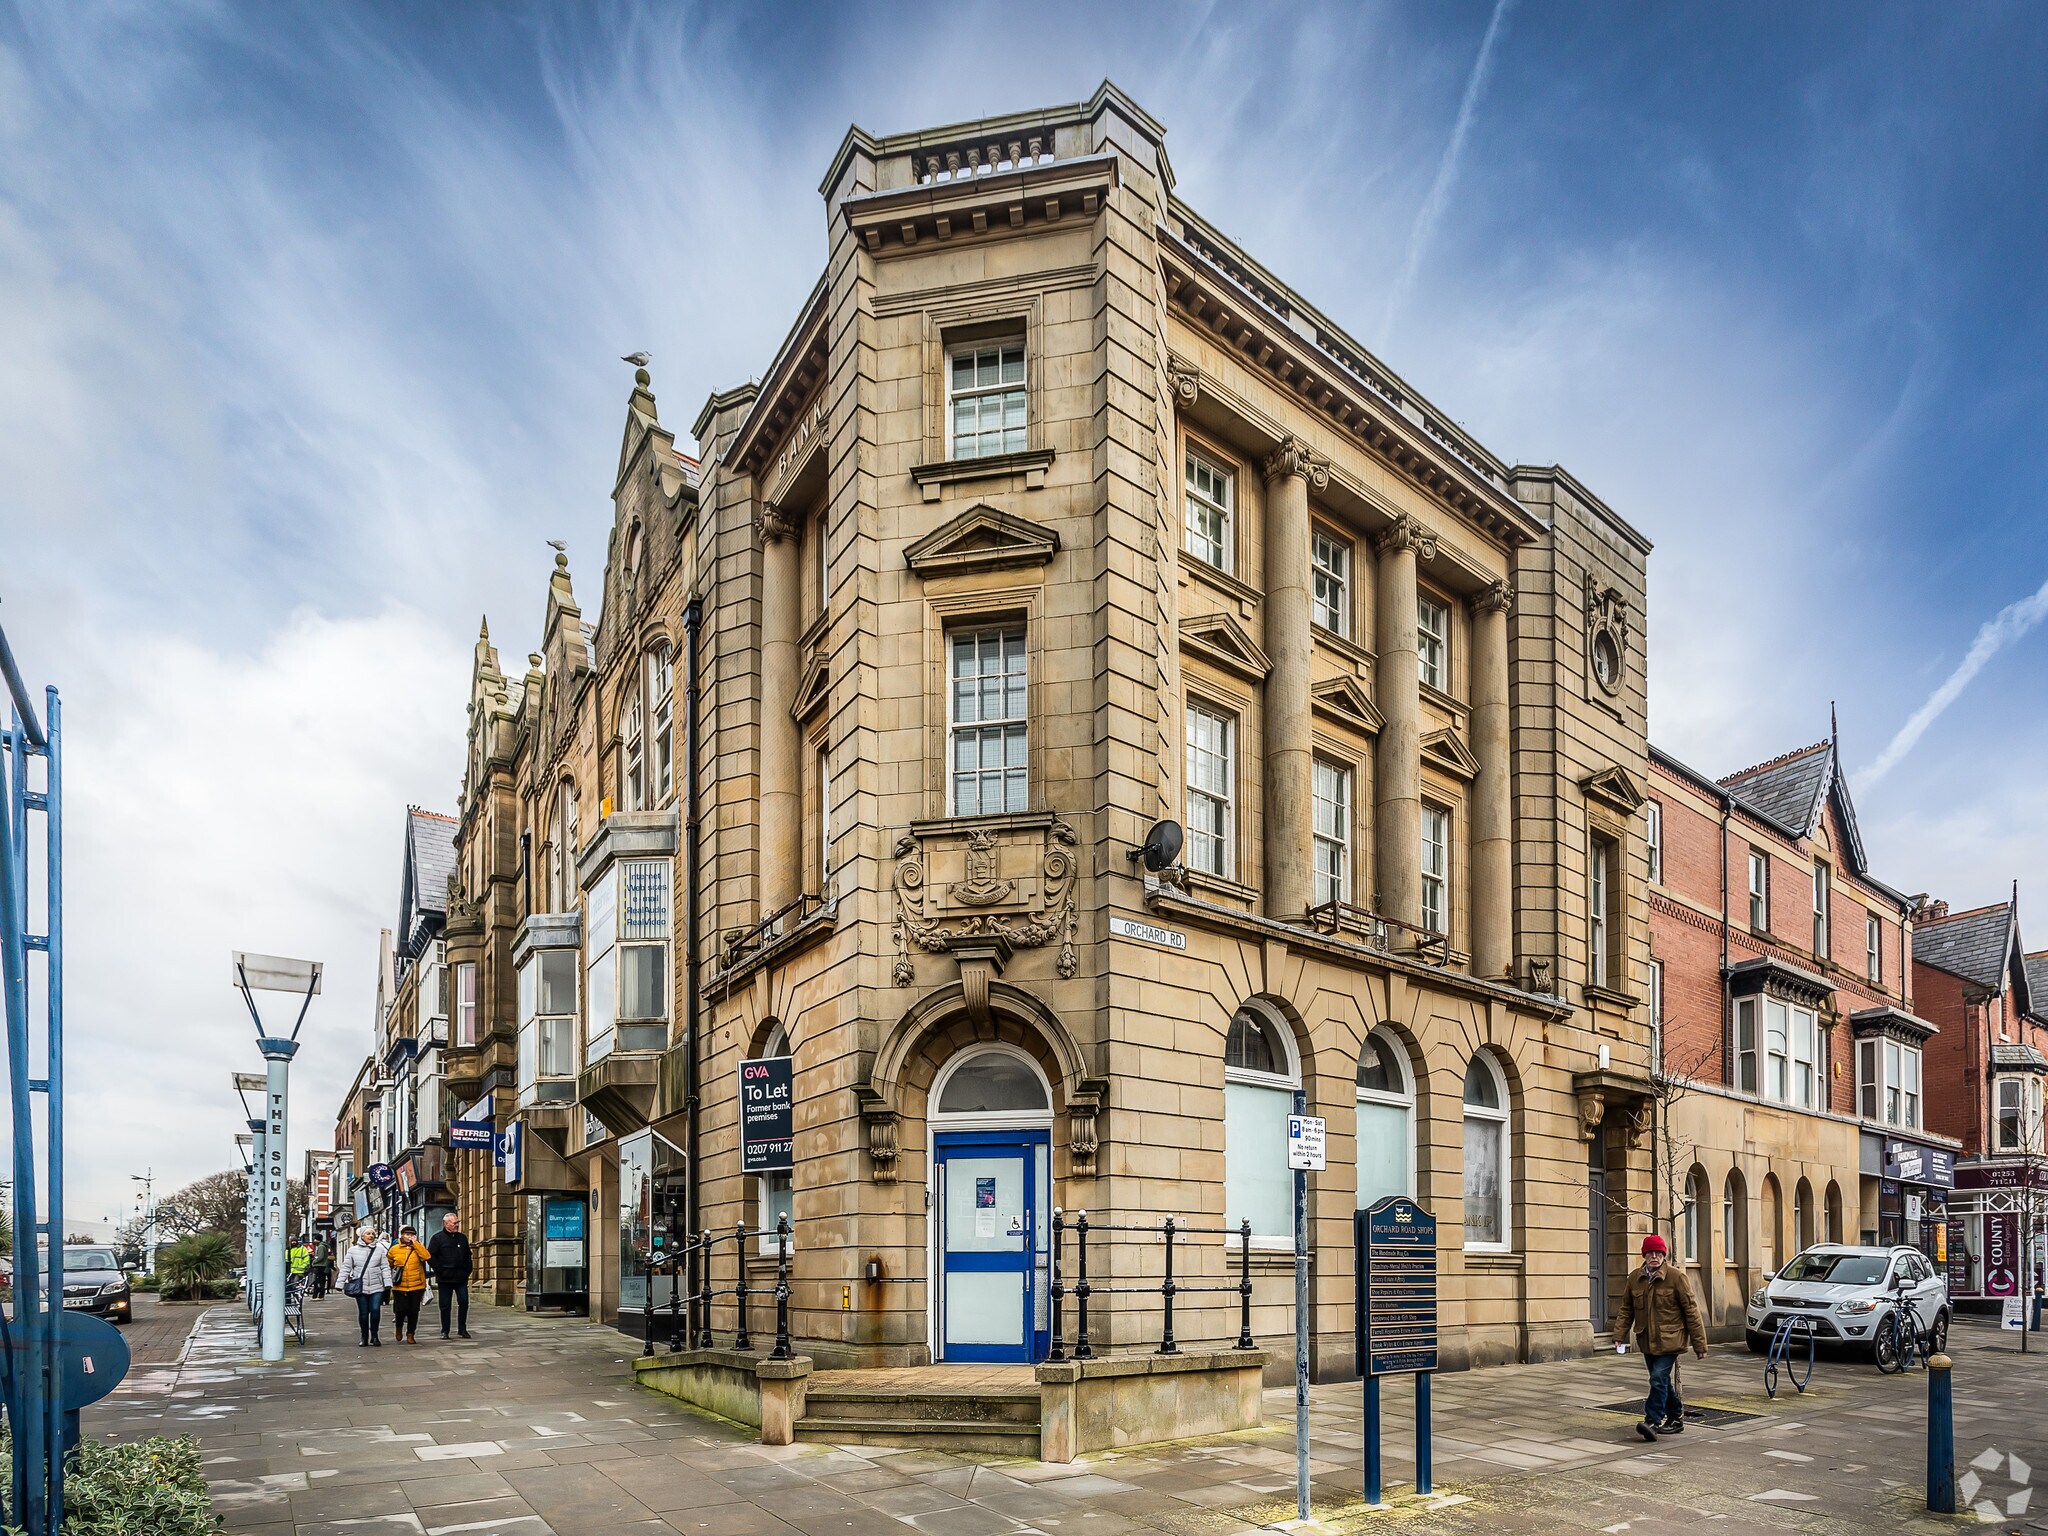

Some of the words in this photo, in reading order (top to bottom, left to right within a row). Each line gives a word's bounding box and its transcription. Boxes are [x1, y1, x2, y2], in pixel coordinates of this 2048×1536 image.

[779, 397, 822, 478] BANK
[1124, 922, 1166, 942] ORCHARD
[1170, 933, 1184, 947] RD.
[745, 1066, 769, 1079] GVA
[745, 1085, 762, 1100] To
[766, 1083, 788, 1099] Let
[271, 1094, 282, 1135] THE
[747, 1104, 771, 1113] Former
[772, 1101, 791, 1110] bank
[747, 1112, 778, 1124] premises
[452, 1129, 490, 1138] BETFRED
[1291, 1121, 1299, 1137] P
[747, 1144, 768, 1155] 0207
[769, 1143, 782, 1153] 911
[270, 1151, 282, 1237] SQUARE
[1372, 1225, 1399, 1233] ORCHARD
[1401, 1226, 1416, 1234] ROAD
[1991, 1216, 2003, 1265] COUNTY
